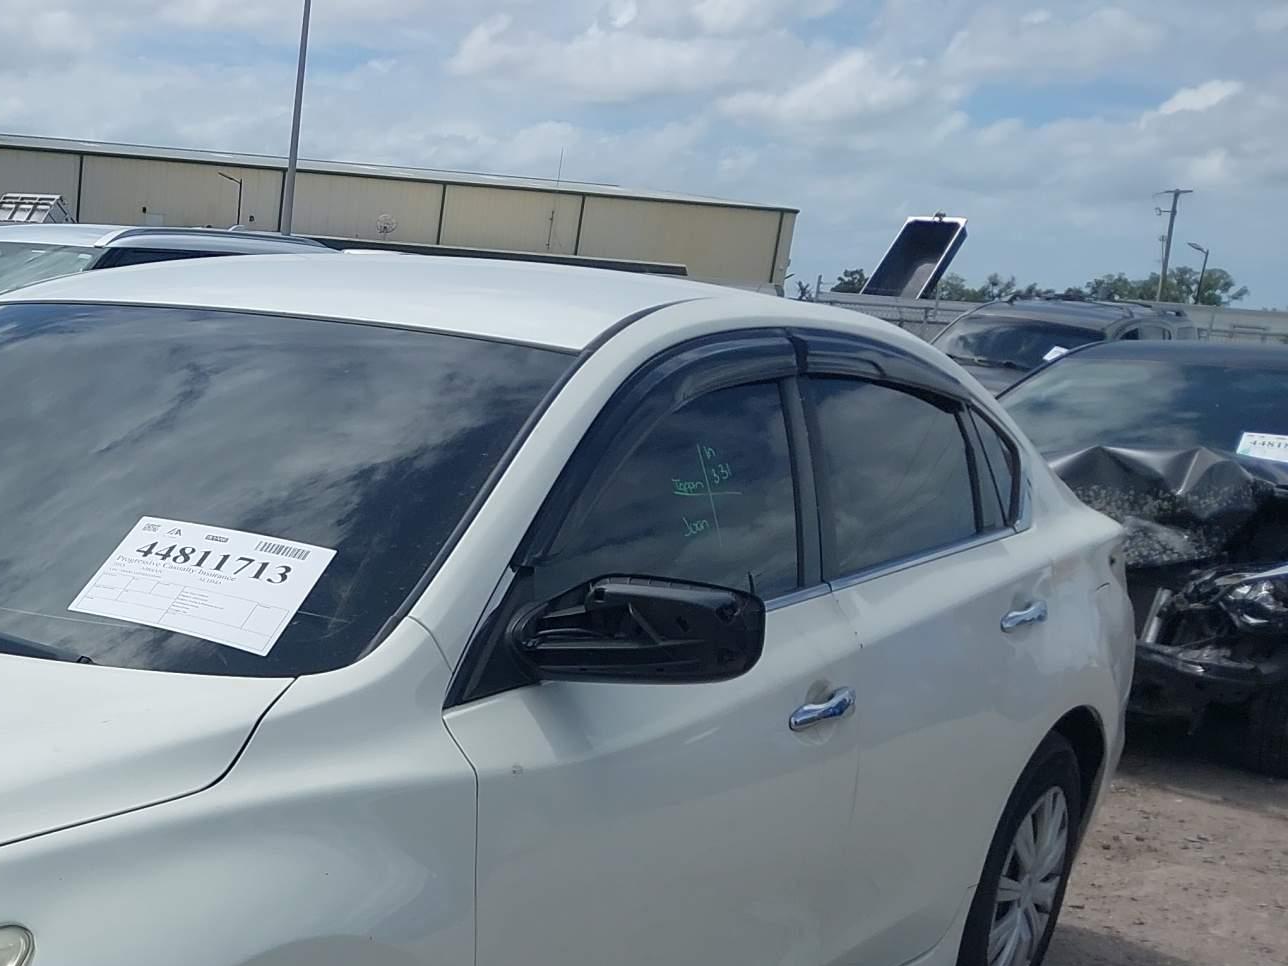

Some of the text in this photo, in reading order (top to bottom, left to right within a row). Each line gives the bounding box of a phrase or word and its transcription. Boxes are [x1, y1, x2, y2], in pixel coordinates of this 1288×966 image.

[116, 554, 162, 568] Progressive
[197, 568, 238, 582] Insurance
[136, 541, 292, 584] 44811713
